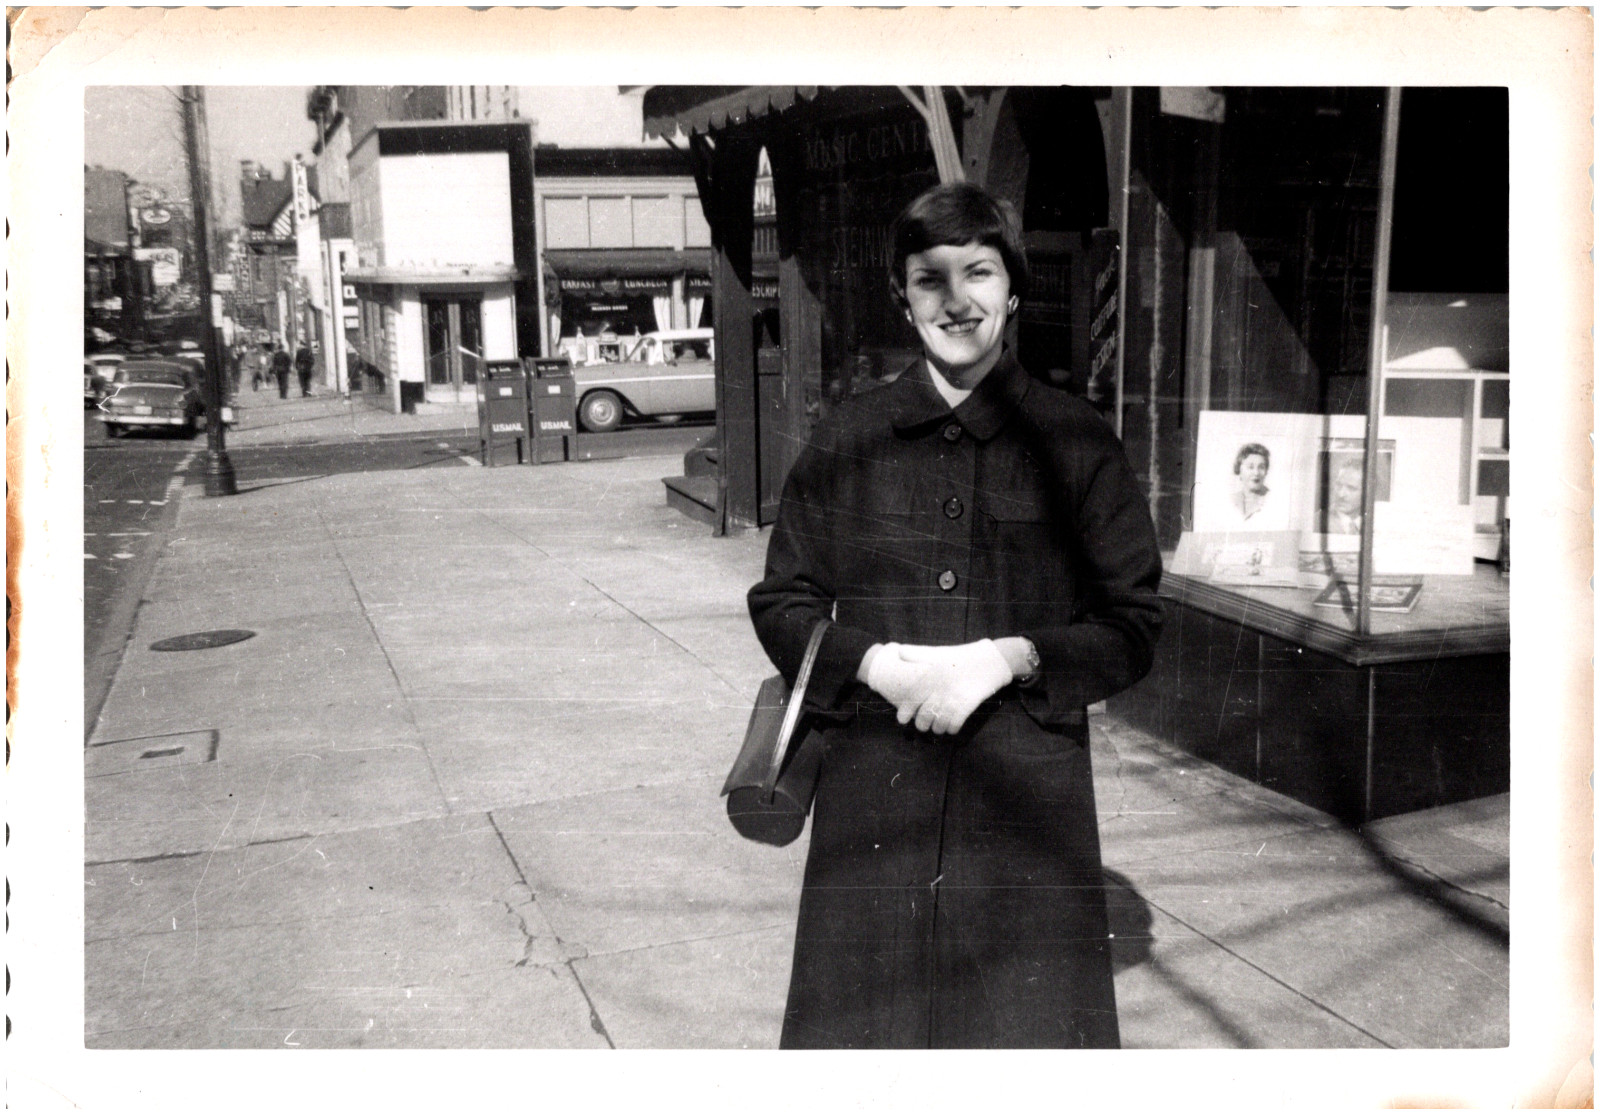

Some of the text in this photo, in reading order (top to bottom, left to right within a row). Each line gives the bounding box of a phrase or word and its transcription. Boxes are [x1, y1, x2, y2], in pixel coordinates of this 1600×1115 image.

[805, 119, 930, 170] MUSIC CENT
[832, 226, 897, 268] STEINW
[624, 280, 668, 289] LUNCHEON
